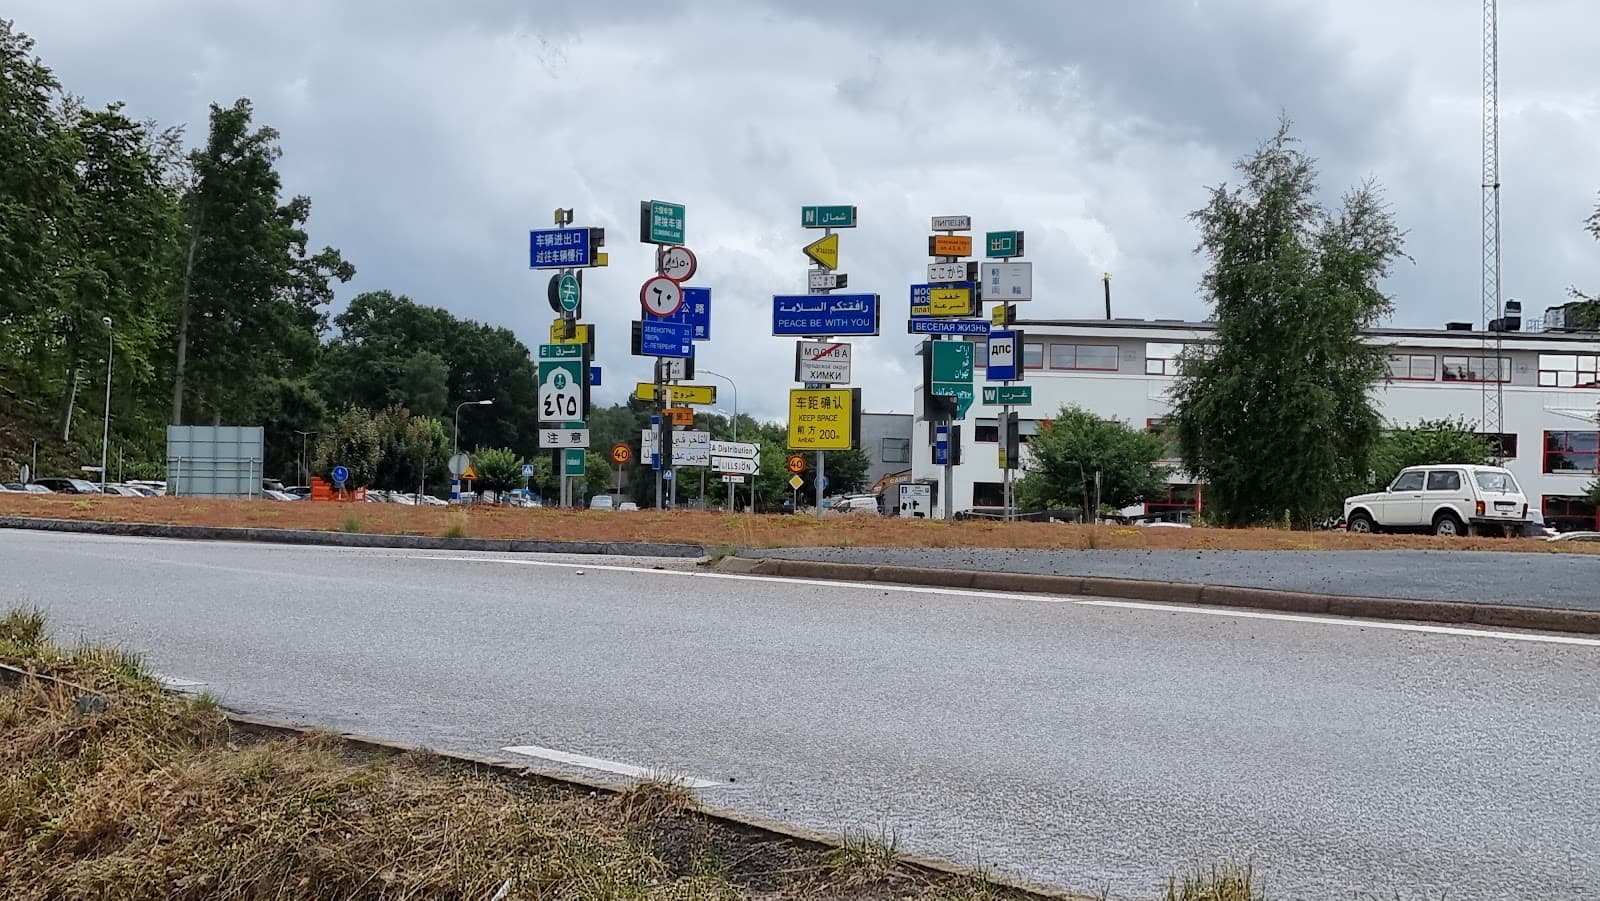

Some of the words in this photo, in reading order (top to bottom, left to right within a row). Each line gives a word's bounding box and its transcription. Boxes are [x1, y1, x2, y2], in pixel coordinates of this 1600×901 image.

[806, 210, 814, 222] N
[822, 212, 846, 222] شمال
[536, 232, 581, 248] 车辆进出口
[992, 238, 1011, 250] 出口
[536, 248, 584, 263] 过往车辆慢行
[930, 266, 964, 279] ここから
[653, 287, 672, 306] ٦٠
[780, 302, 826, 312] السلامة
[830, 301, 868, 314] رافقتكم
[644, 326, 676, 335] ЗЕЛЕНОГРАД
[916, 323, 954, 332] ВЕСЕЛАЯ
[958, 324, 987, 332] ЖИЗНЬ
[542, 346, 547, 356] E
[556, 346, 576, 356] شرق
[992, 344, 1012, 356] ДПС
[810, 370, 842, 380] ХИМКИ
[984, 390, 995, 400] W
[1002, 391, 1028, 399] غرب
[544, 394, 576, 416] ٤٢٥
[796, 396, 843, 410] 车距确认
[797, 426, 816, 435] 前方
[718, 444, 752, 454] Distribution
[722, 460, 750, 471] LILLSJÖN
